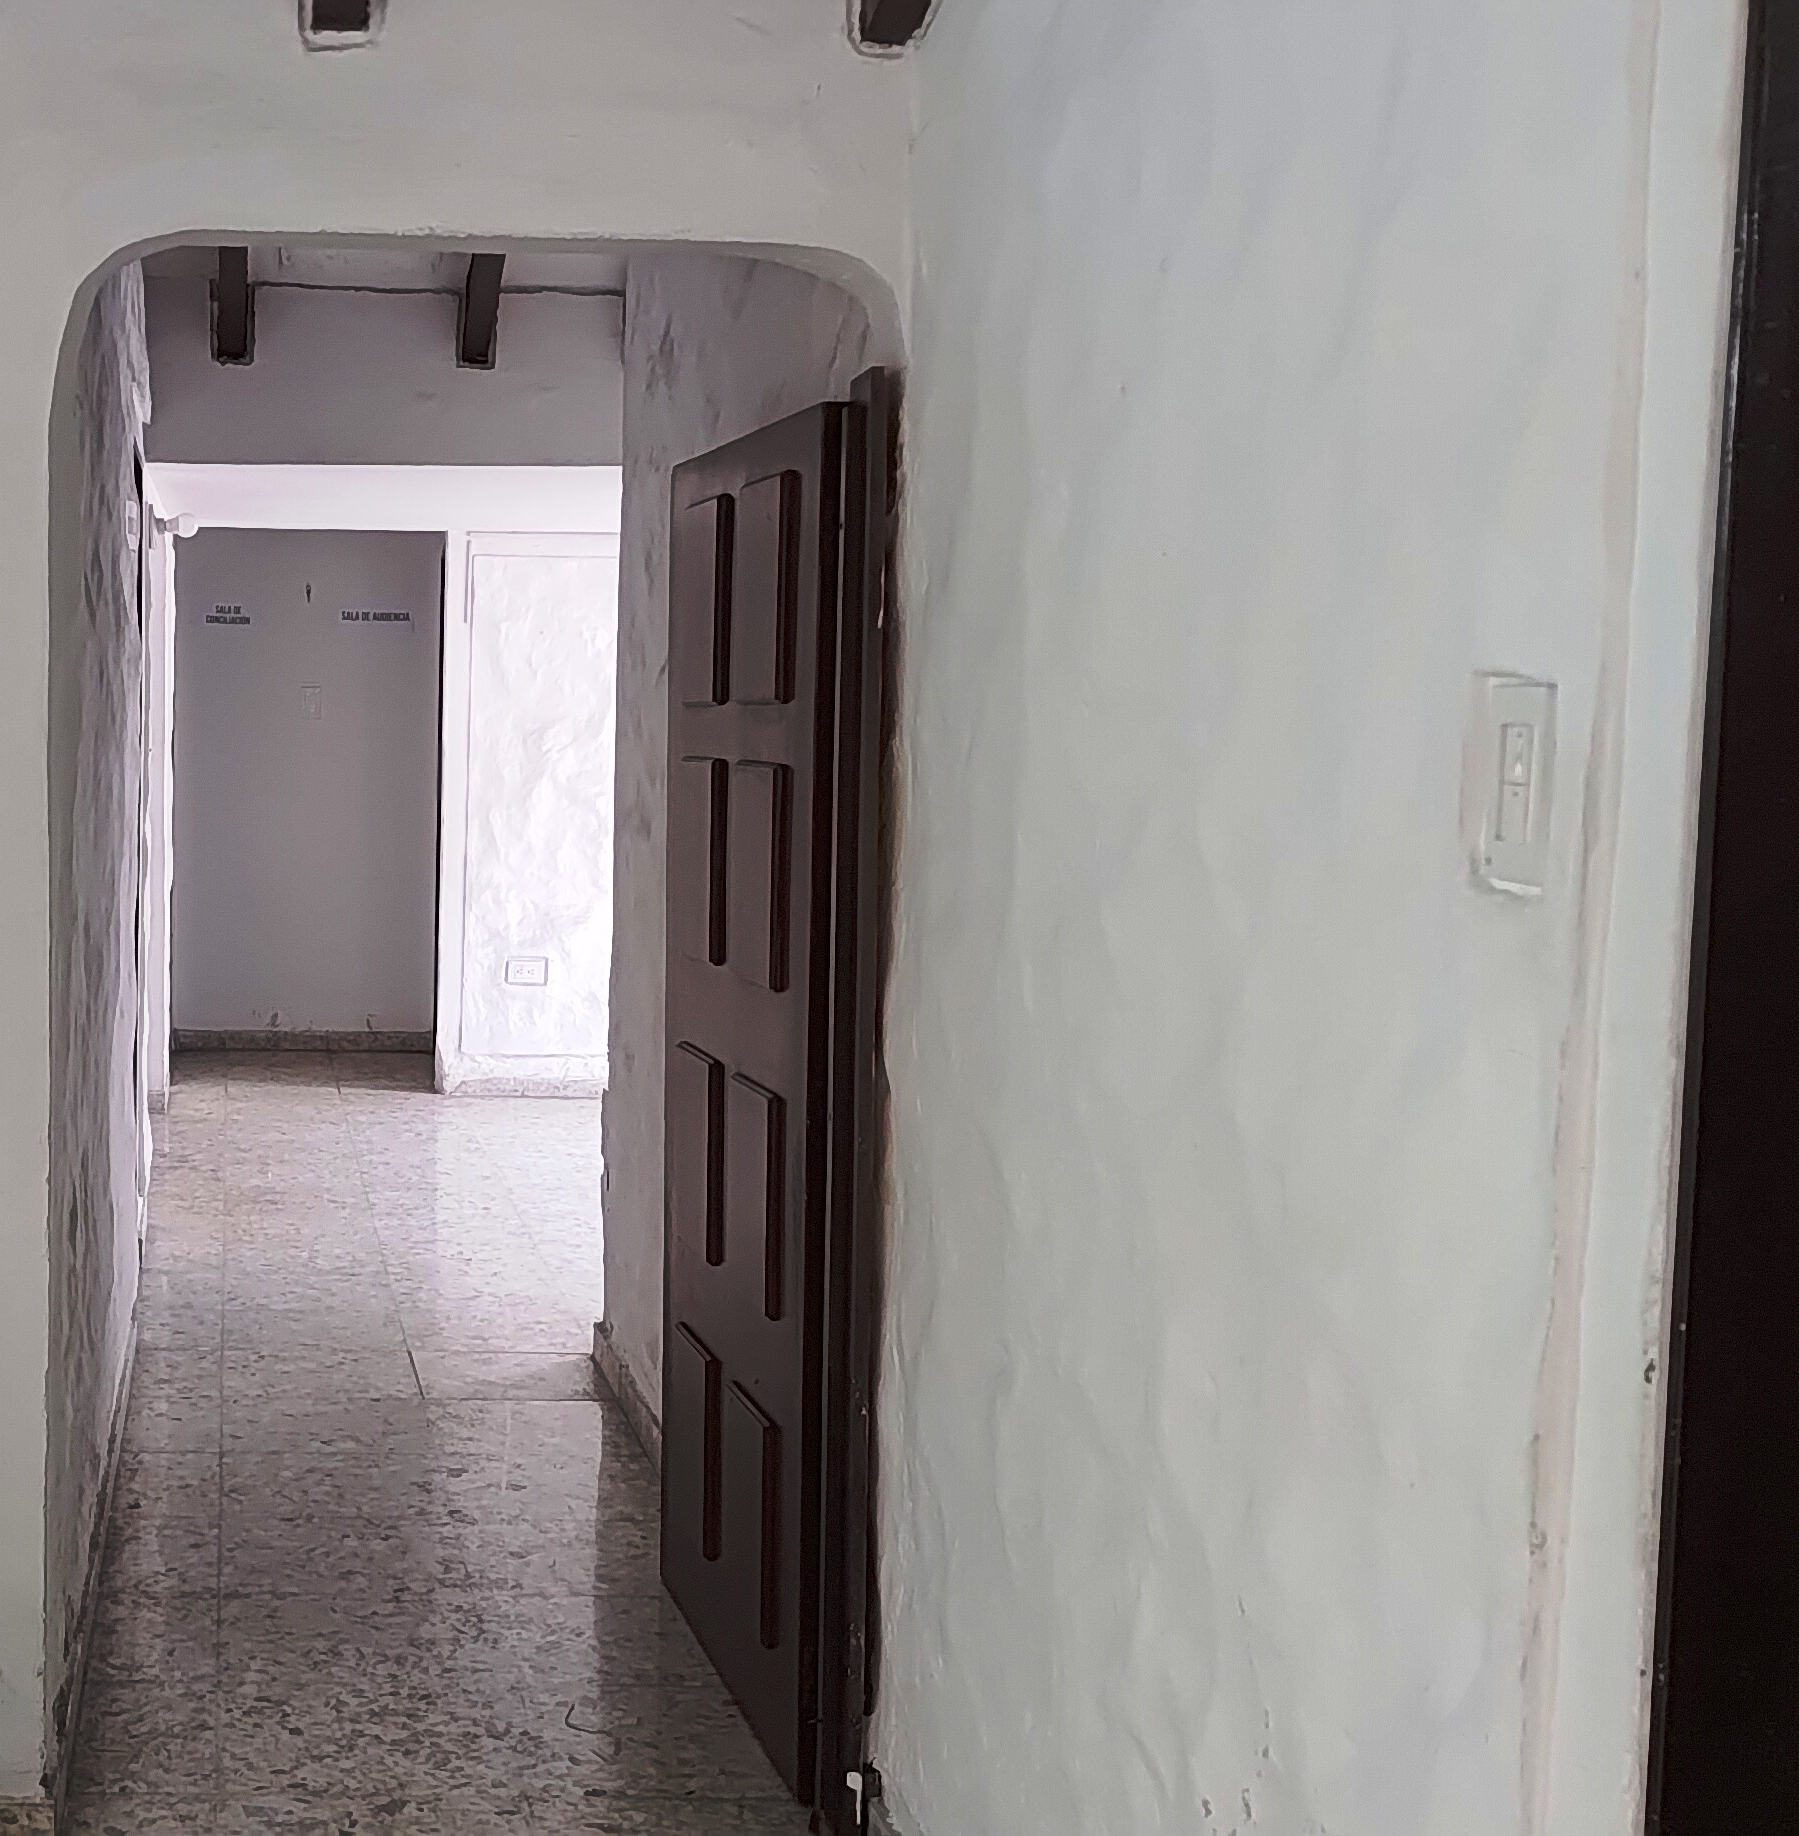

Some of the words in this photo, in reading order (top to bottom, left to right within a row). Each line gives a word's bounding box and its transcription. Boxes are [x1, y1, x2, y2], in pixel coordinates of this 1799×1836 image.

[215, 604, 232, 615] SALA
[233, 605, 242, 615] DE
[341, 610, 360, 621] SALA
[361, 611, 371, 622] DE
[372, 612, 411, 622] AUDIENCIA
